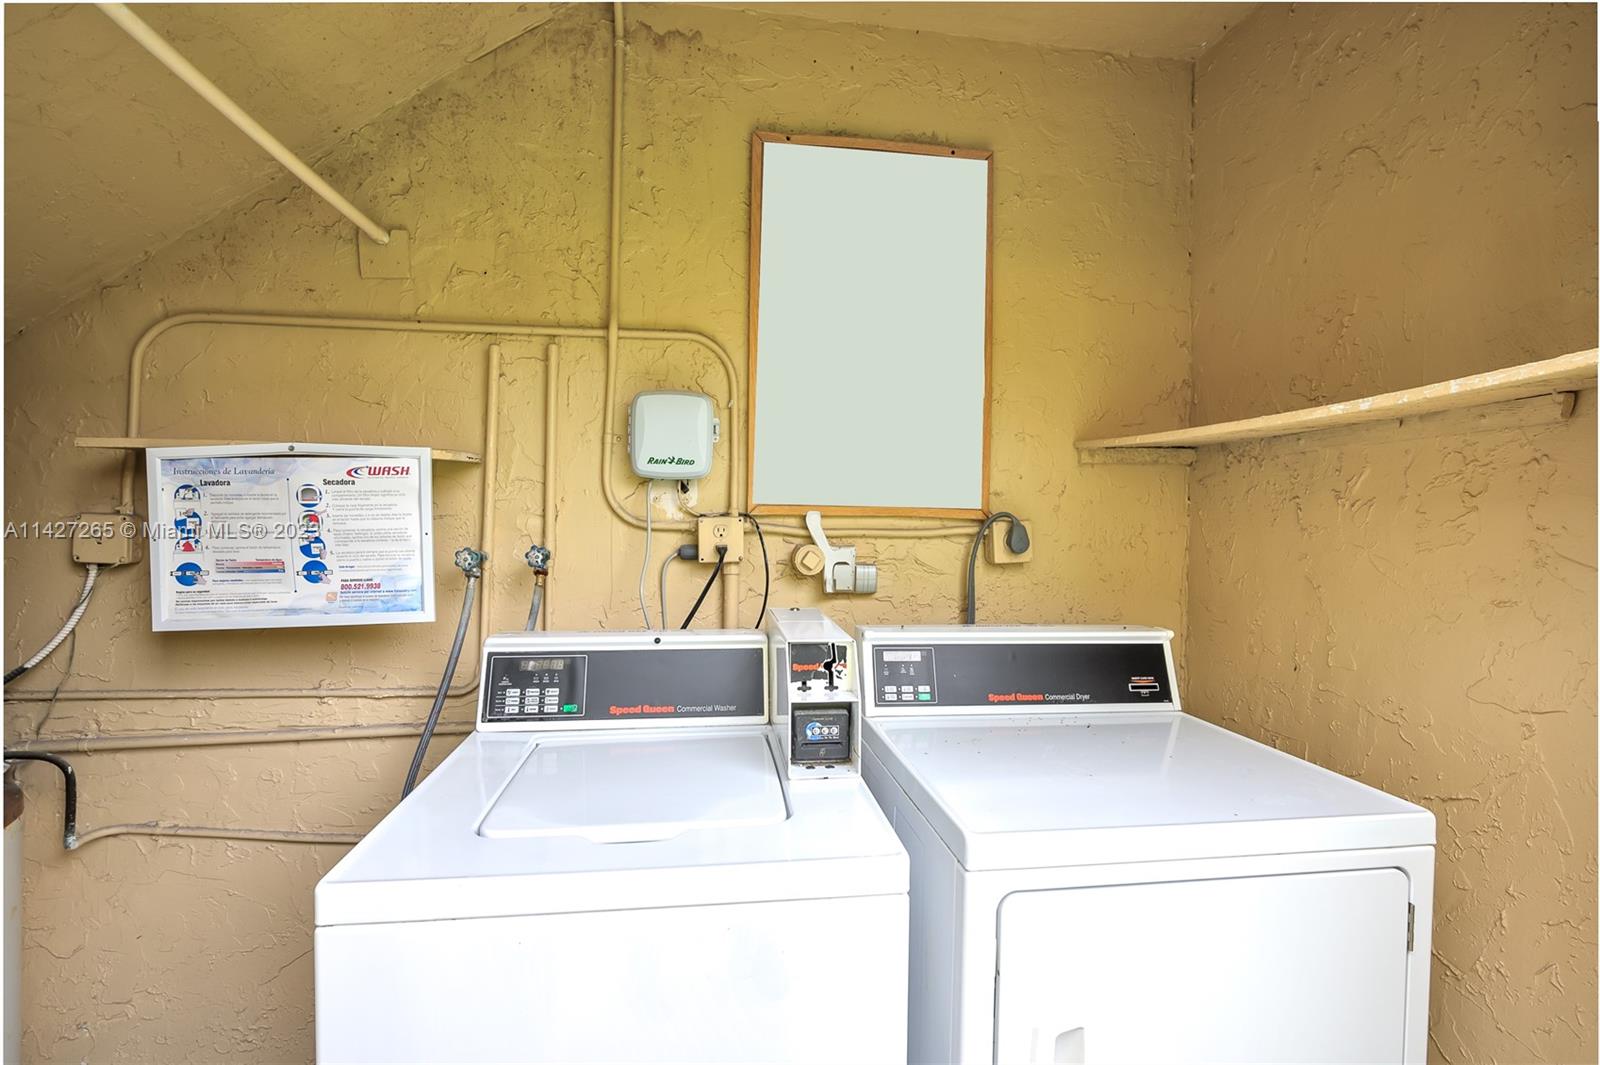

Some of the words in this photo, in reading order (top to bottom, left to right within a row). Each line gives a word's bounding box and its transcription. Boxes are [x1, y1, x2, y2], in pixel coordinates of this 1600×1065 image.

[647, 456, 668, 465] RAIN
[675, 457, 695, 466] BIRD
[222, 467, 232, 475] de
[367, 465, 410, 476] WASH
[322, 478, 356, 486] Secadora
[988, 693, 1016, 702] Speed
[1016, 692, 1044, 702] Queen
[1045, 693, 1076, 701] Commercial
[1076, 693, 1090, 702] Dryer
[609, 704, 641, 715] Speed
[642, 704, 675, 714] Queen
[676, 704, 713, 713] Commercial
[714, 704, 737, 712] Washer
